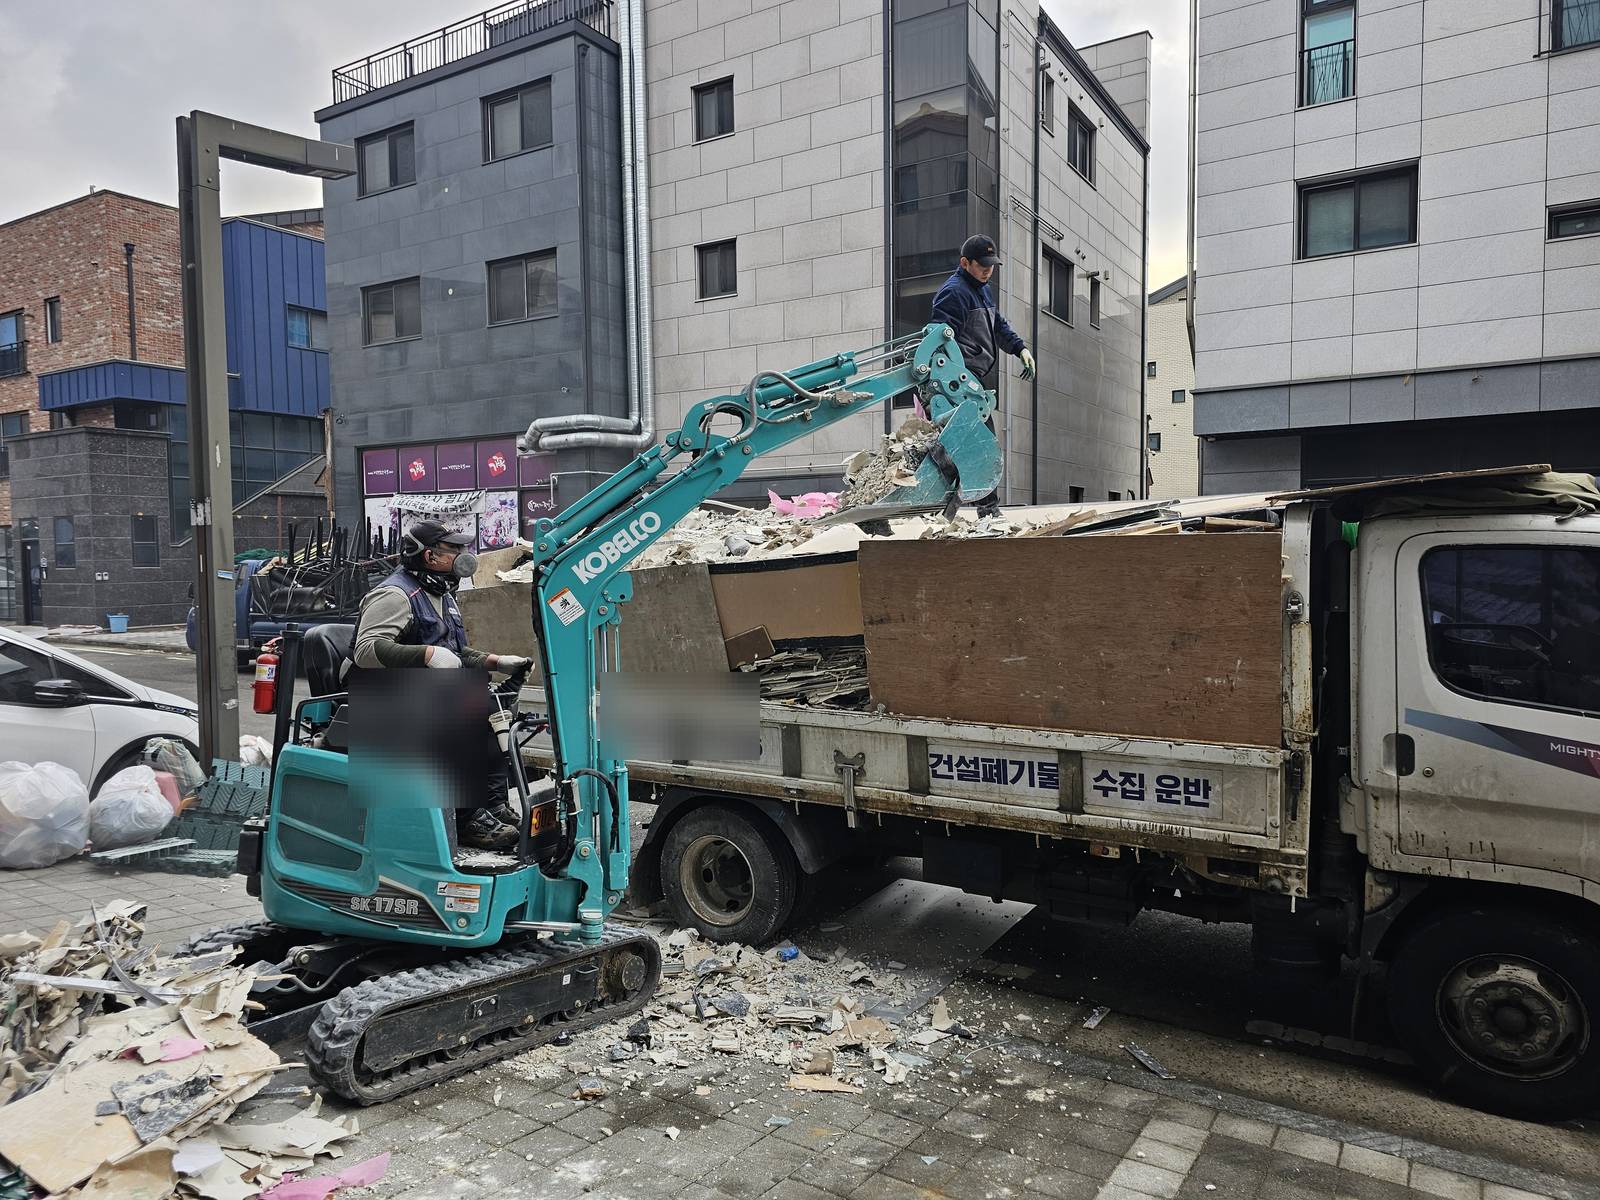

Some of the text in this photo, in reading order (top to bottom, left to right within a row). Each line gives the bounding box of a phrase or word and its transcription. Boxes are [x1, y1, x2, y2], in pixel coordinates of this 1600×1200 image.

[571, 511, 662, 585] KOBELCO
[929, 752, 1212, 808] 건설폐기물 수집 운반
[350, 896, 419, 915] SK 17SR
